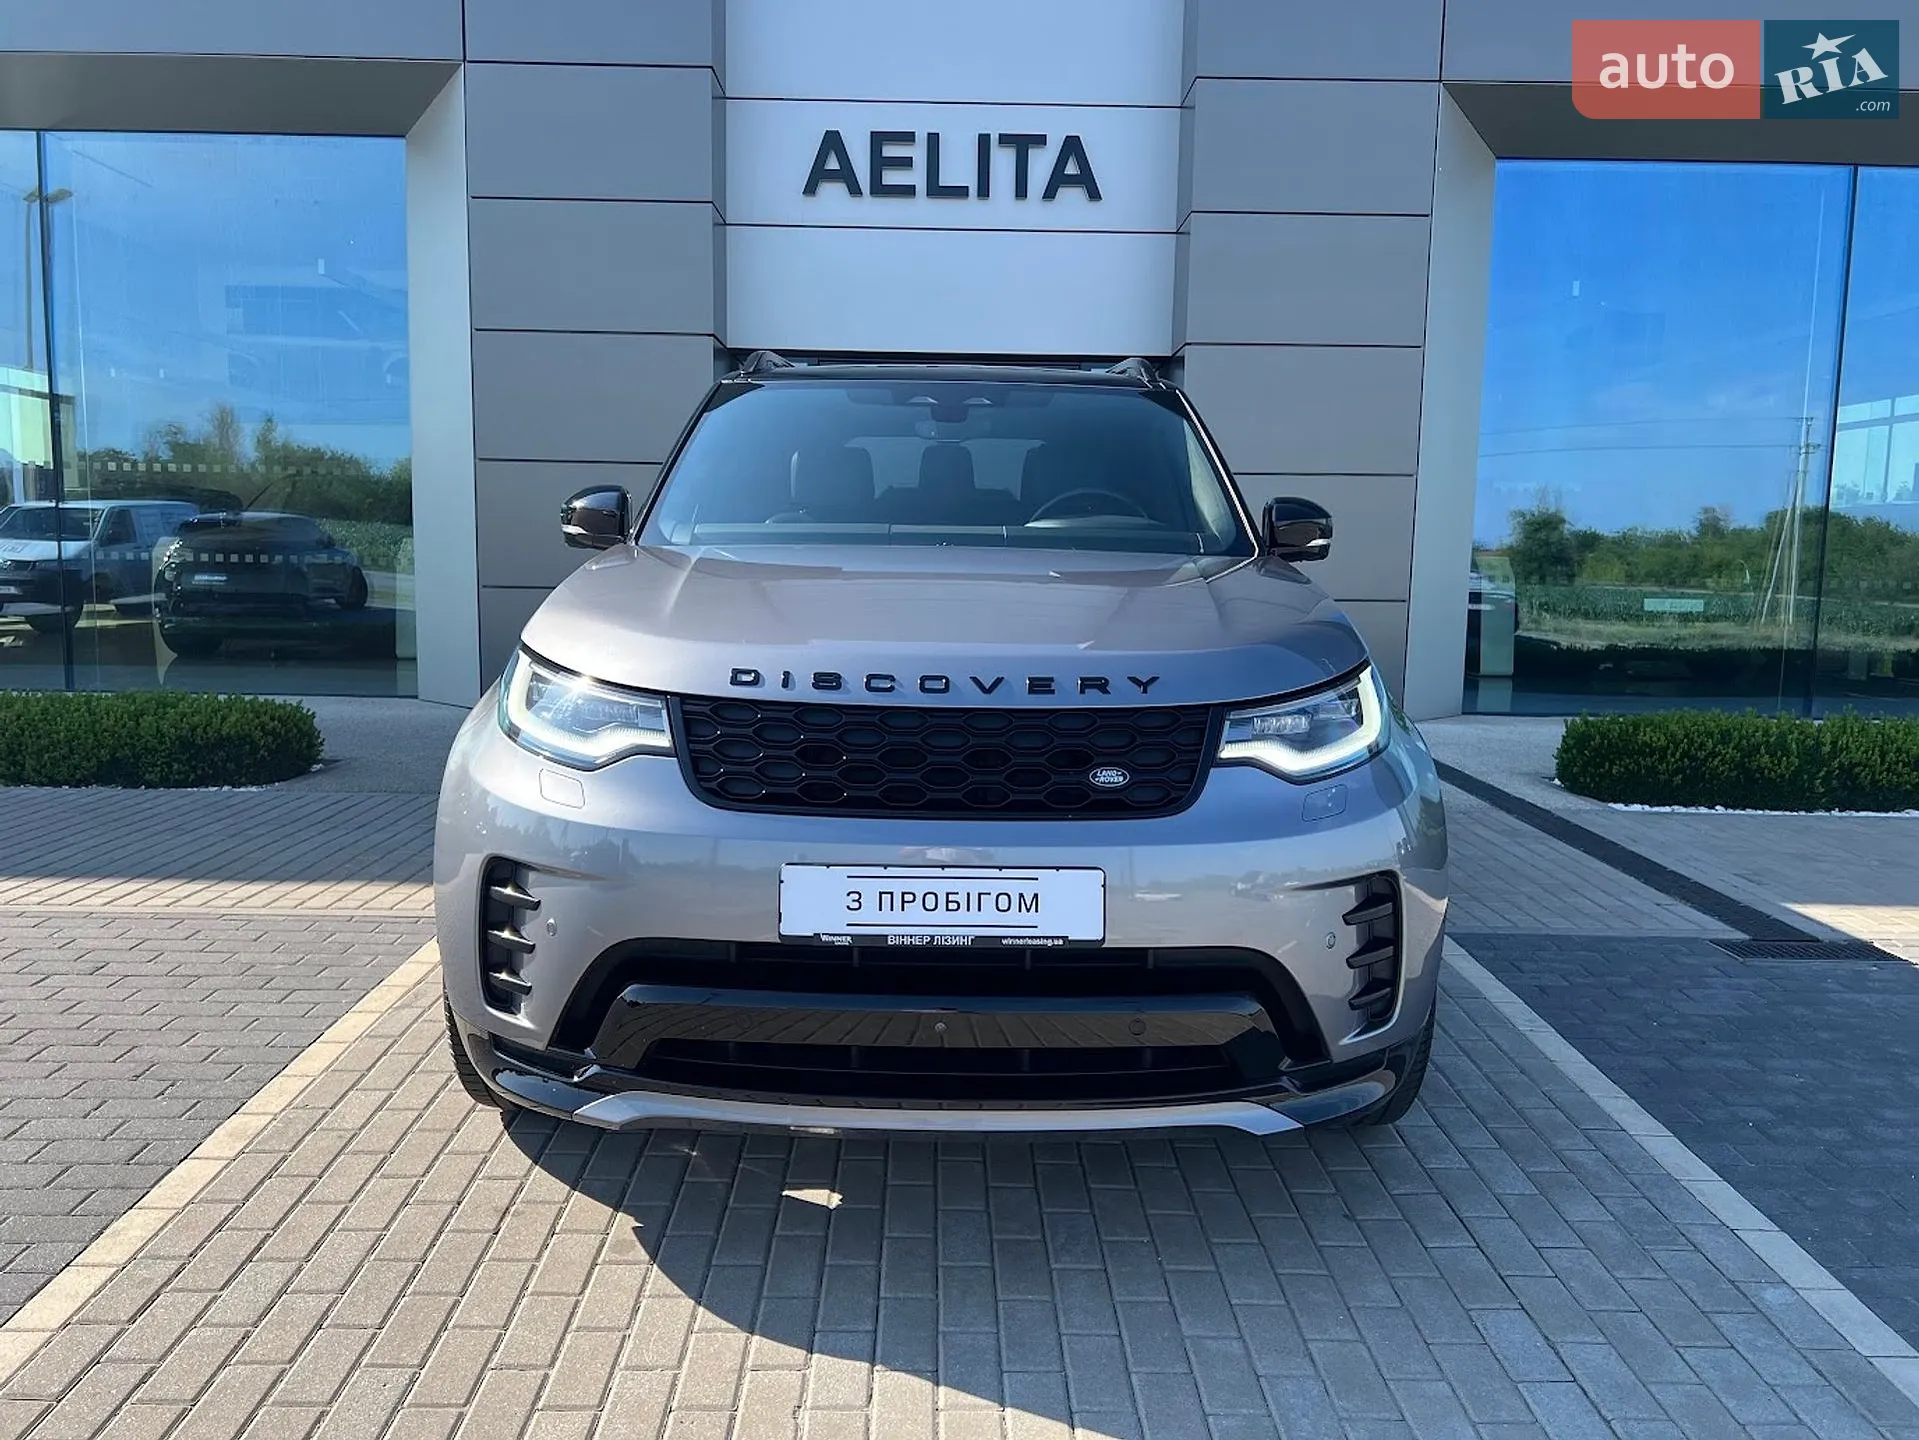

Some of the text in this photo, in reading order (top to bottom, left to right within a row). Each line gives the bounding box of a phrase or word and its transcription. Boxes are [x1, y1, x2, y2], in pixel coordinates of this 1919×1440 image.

[802, 129, 1102, 200] AELITA
[729, 667, 1159, 695] DISCOVERY
[846, 891, 1040, 914] З ПРОБІГОМ
[887, 935, 975, 947] ВІННЕР ЛІЗИНГ
